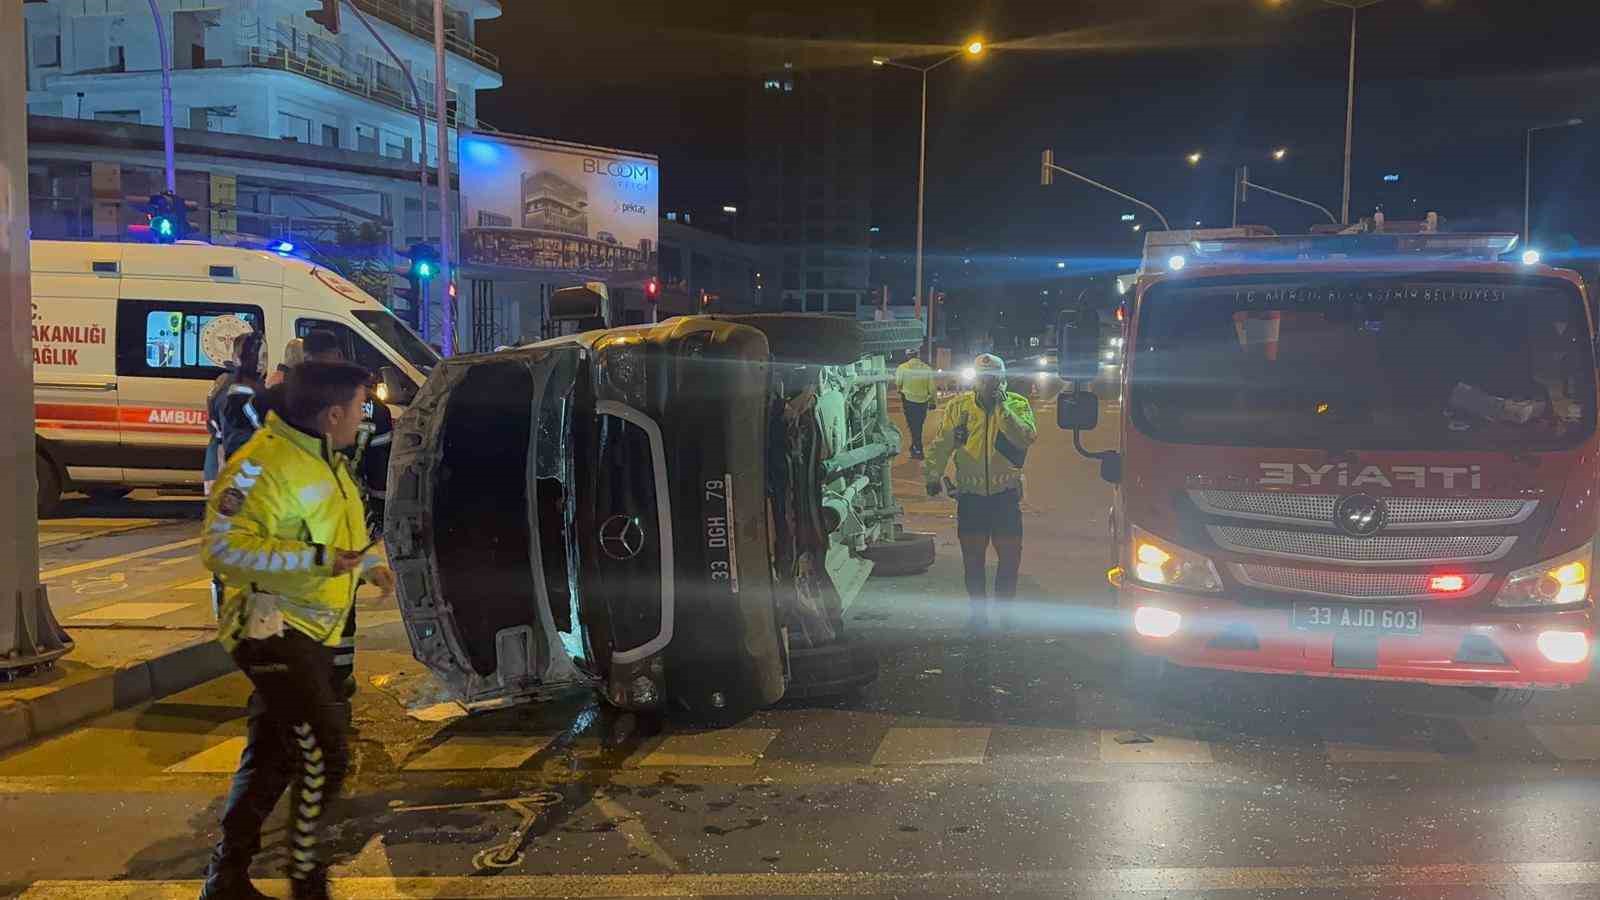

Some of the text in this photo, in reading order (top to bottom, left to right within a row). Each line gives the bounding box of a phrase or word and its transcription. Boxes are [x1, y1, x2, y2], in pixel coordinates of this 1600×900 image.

[583, 158, 648, 180] BLOOM
[31, 323, 106, 345] AKANLIĞI
[32, 344, 78, 366] AĞLIK
[148, 409, 208, 425] AMBUL
[706, 480, 729, 580] 33 DGH 79
[1309, 606, 1417, 629] 33 AJD 603
